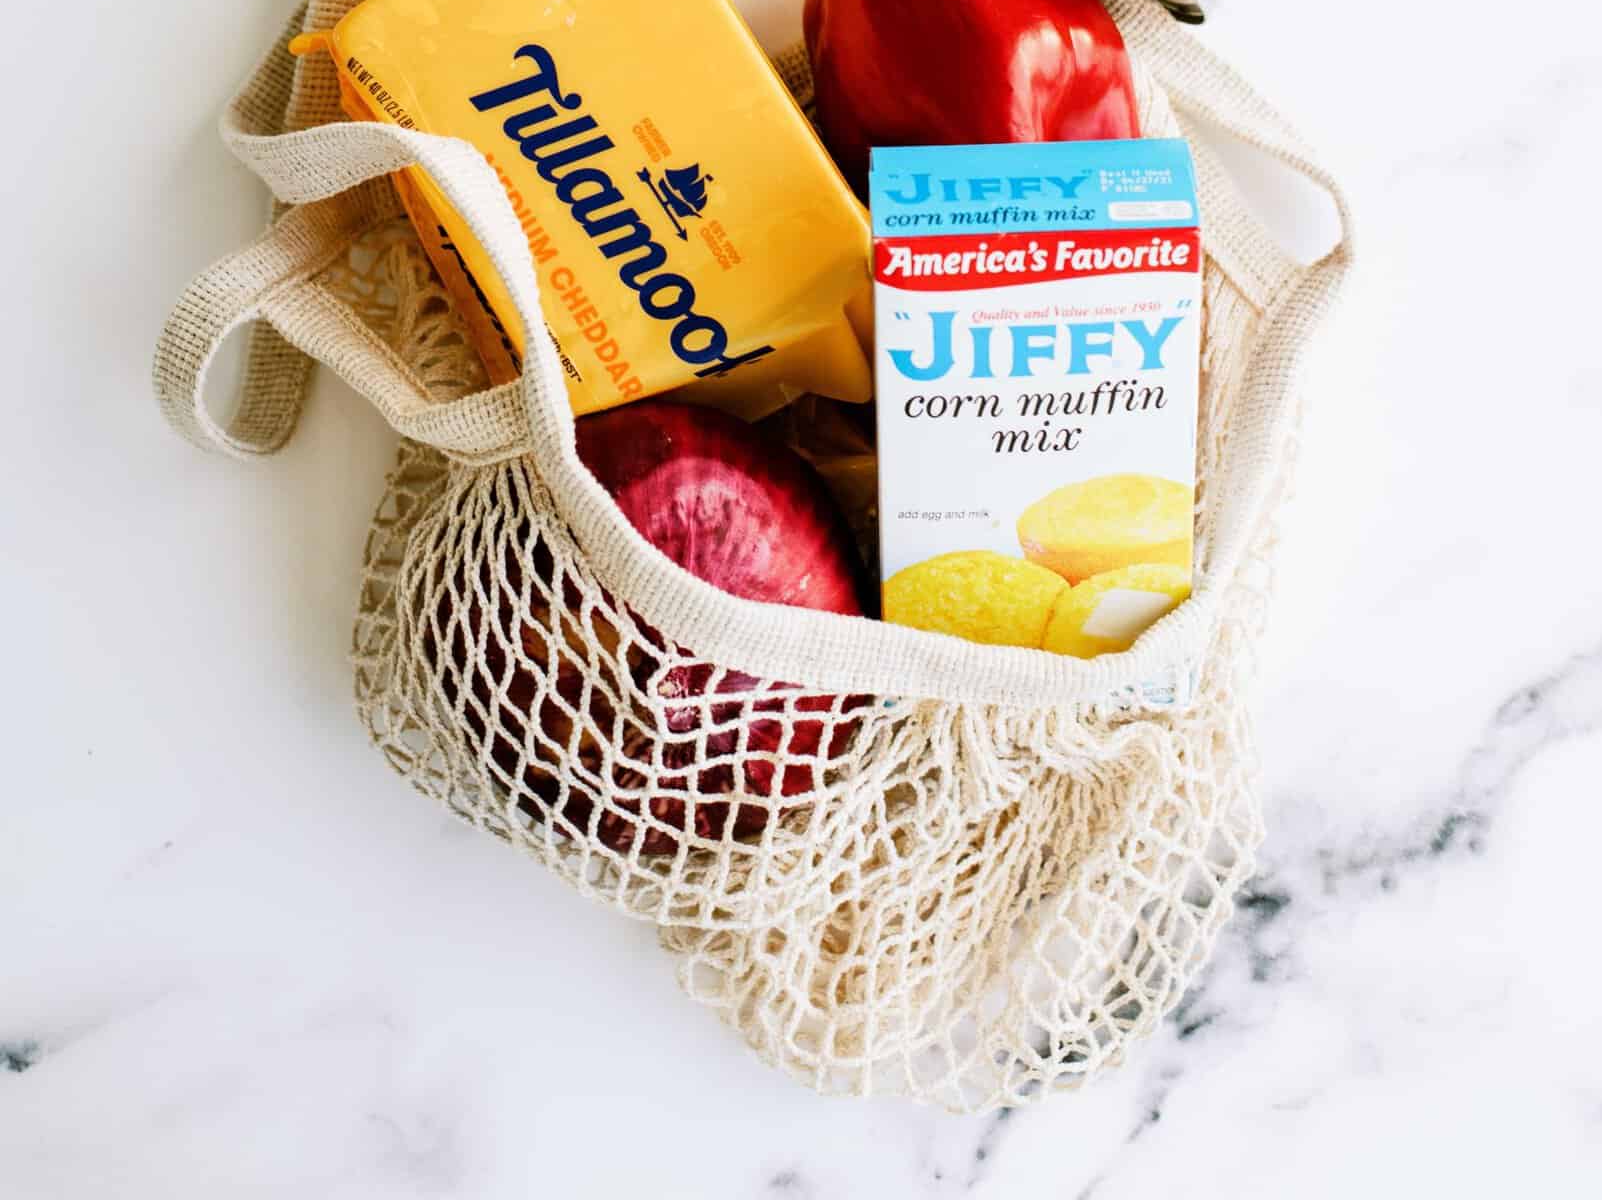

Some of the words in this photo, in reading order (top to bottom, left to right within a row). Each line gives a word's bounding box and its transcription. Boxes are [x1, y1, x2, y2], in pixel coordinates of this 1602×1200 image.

[347, 56, 363, 75] NET
[357, 69, 374, 86] WT
[375, 90, 392, 105] OZ
[631, 124, 662, 164] OWNED
[639, 116, 672, 158] FARMER
[884, 210, 944, 227] corn
[950, 205, 1039, 226] muffin
[1043, 204, 1096, 222] mix
[700, 226, 732, 272] OREGON
[882, 241, 1049, 278] America's
[1054, 236, 1191, 272] Favorite
[549, 265, 644, 400] CHEDDAR
[971, 308, 1020, 324] Quality
[1023, 305, 1050, 319] and
[1053, 304, 1090, 319] Value
[1094, 304, 1128, 316] since
[903, 391, 1004, 419] corn
[1014, 378, 1168, 417] muffin
[991, 420, 1084, 454] mix
[897, 506, 920, 520] add
[921, 511, 942, 522] egg
[944, 506, 965, 520] and
[967, 506, 990, 520] milk
